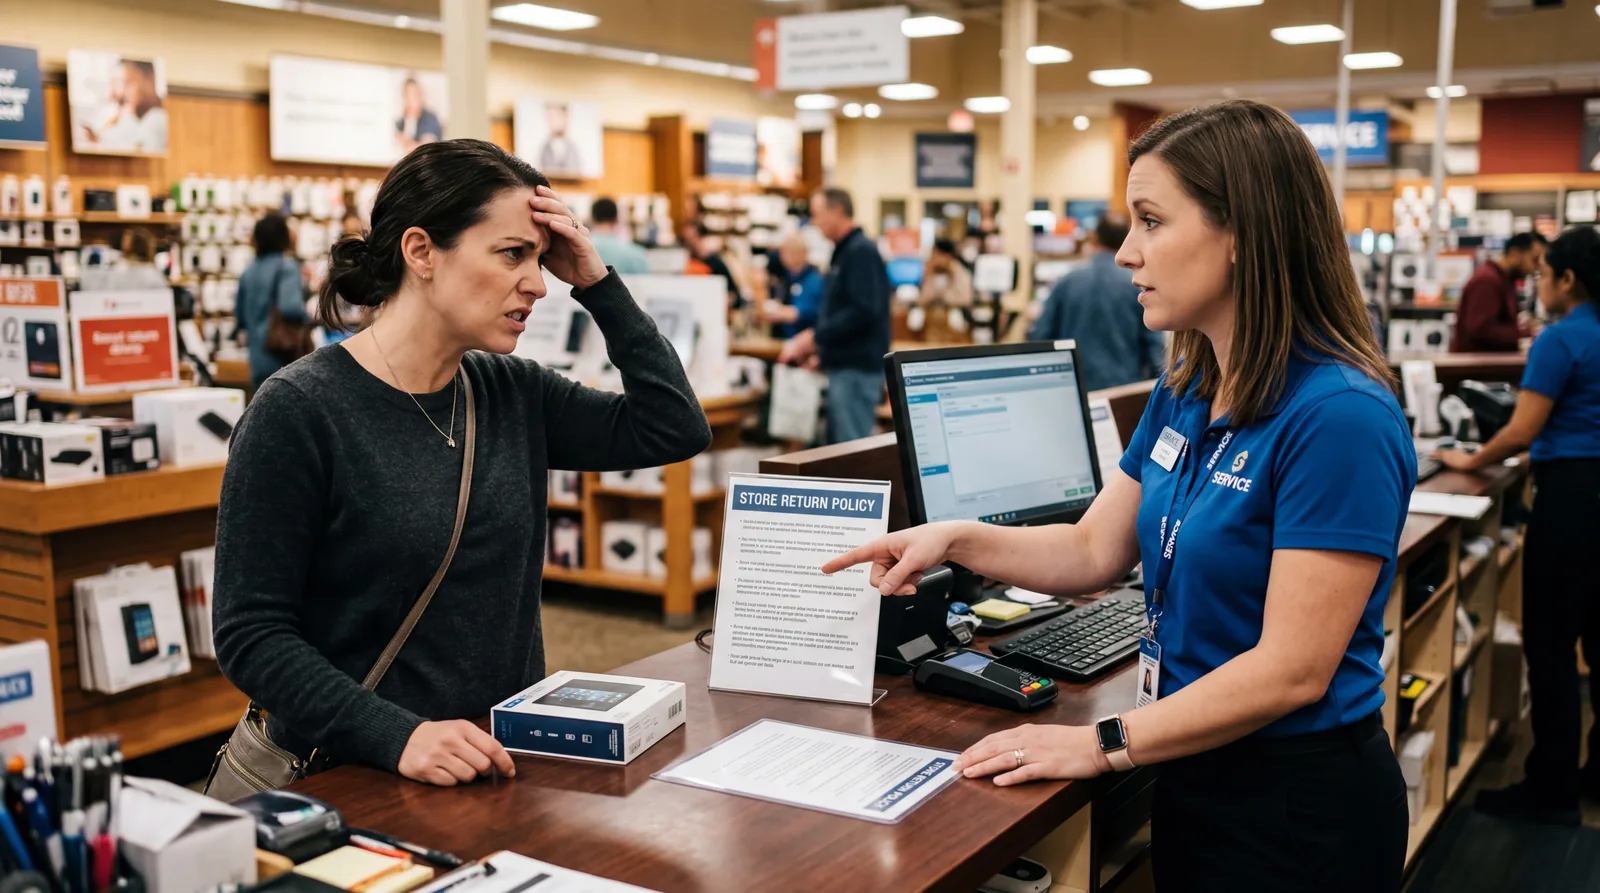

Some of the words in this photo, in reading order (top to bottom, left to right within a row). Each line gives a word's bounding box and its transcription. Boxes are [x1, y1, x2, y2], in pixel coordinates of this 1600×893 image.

[1212, 471, 1252, 492] SERVICE
[740, 491, 778, 506] STORE
[781, 494, 828, 510] RETURN
[832, 498, 875, 512] POLICY
[1163, 519, 1181, 559] SERVICE
